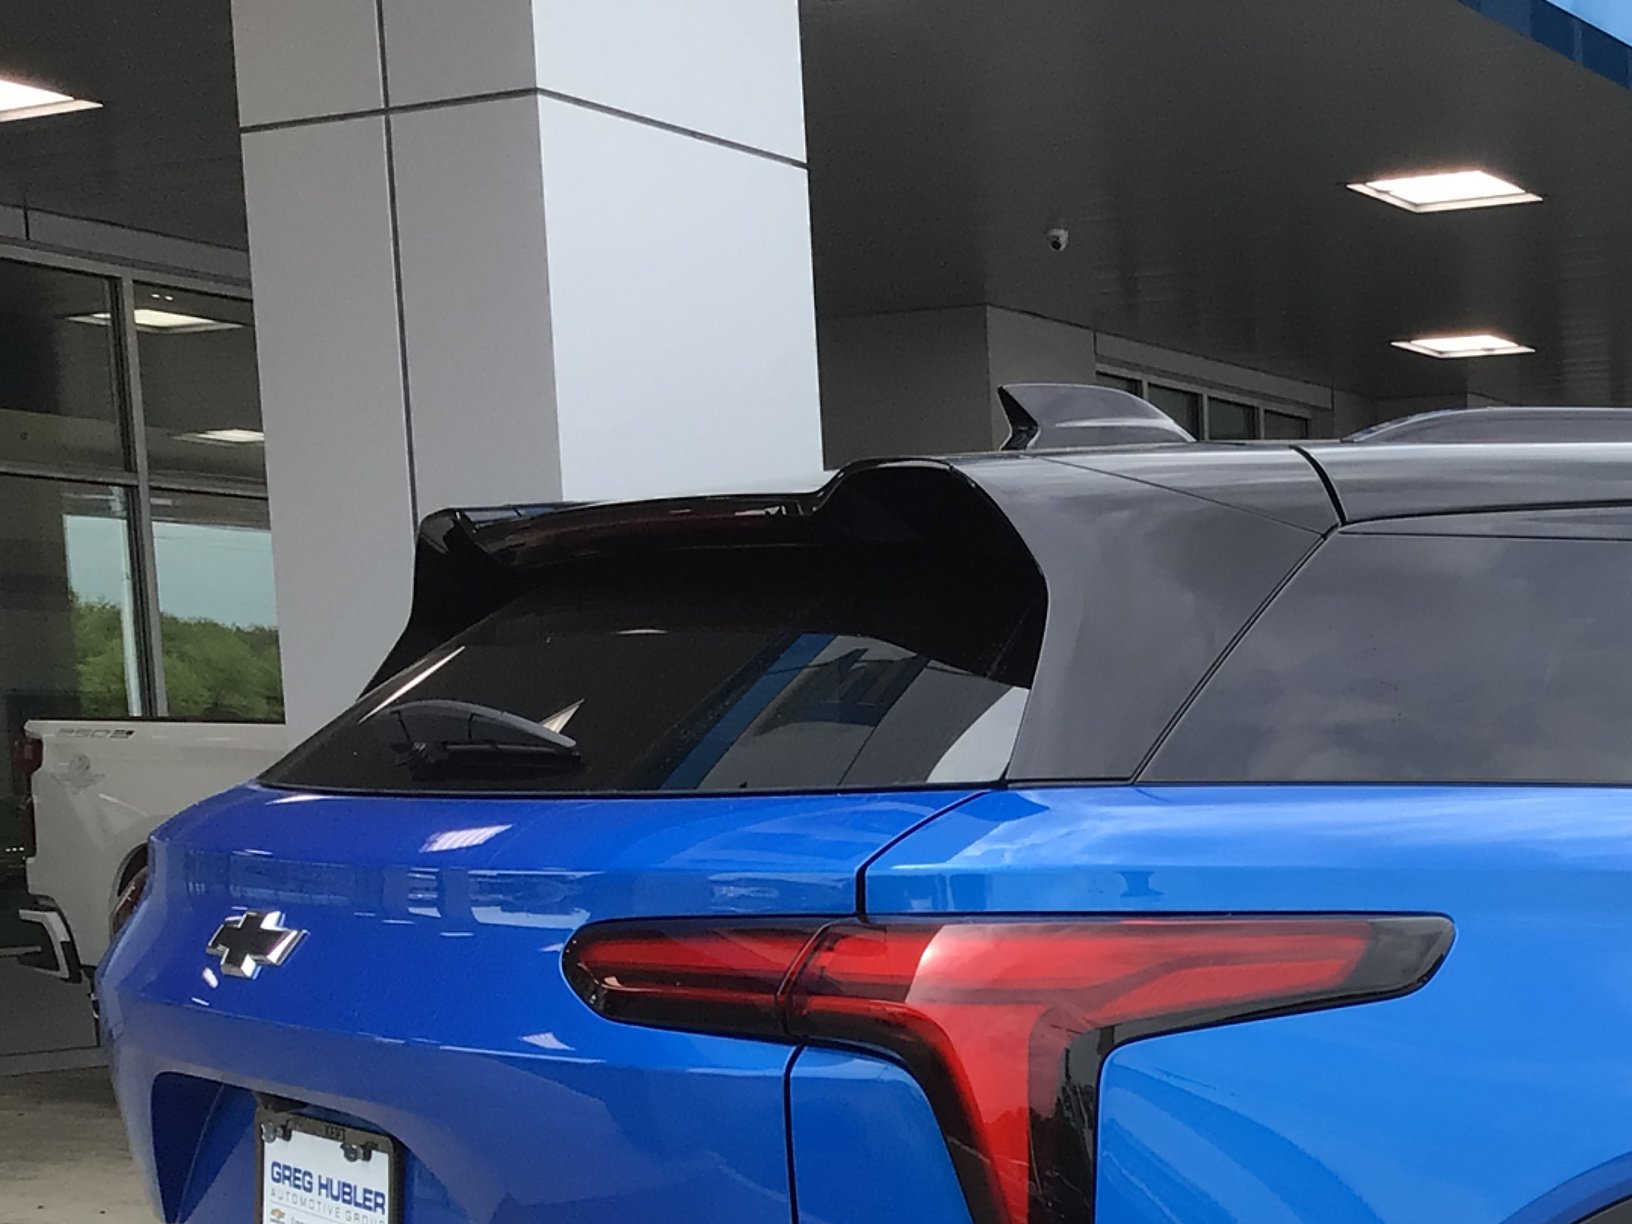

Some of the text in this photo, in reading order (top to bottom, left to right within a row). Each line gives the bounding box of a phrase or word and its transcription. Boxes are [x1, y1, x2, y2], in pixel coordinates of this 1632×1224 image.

[269, 1187, 341, 1219] AUTOMOTIVE
[270, 1161, 386, 1215] GREG HUBLER
